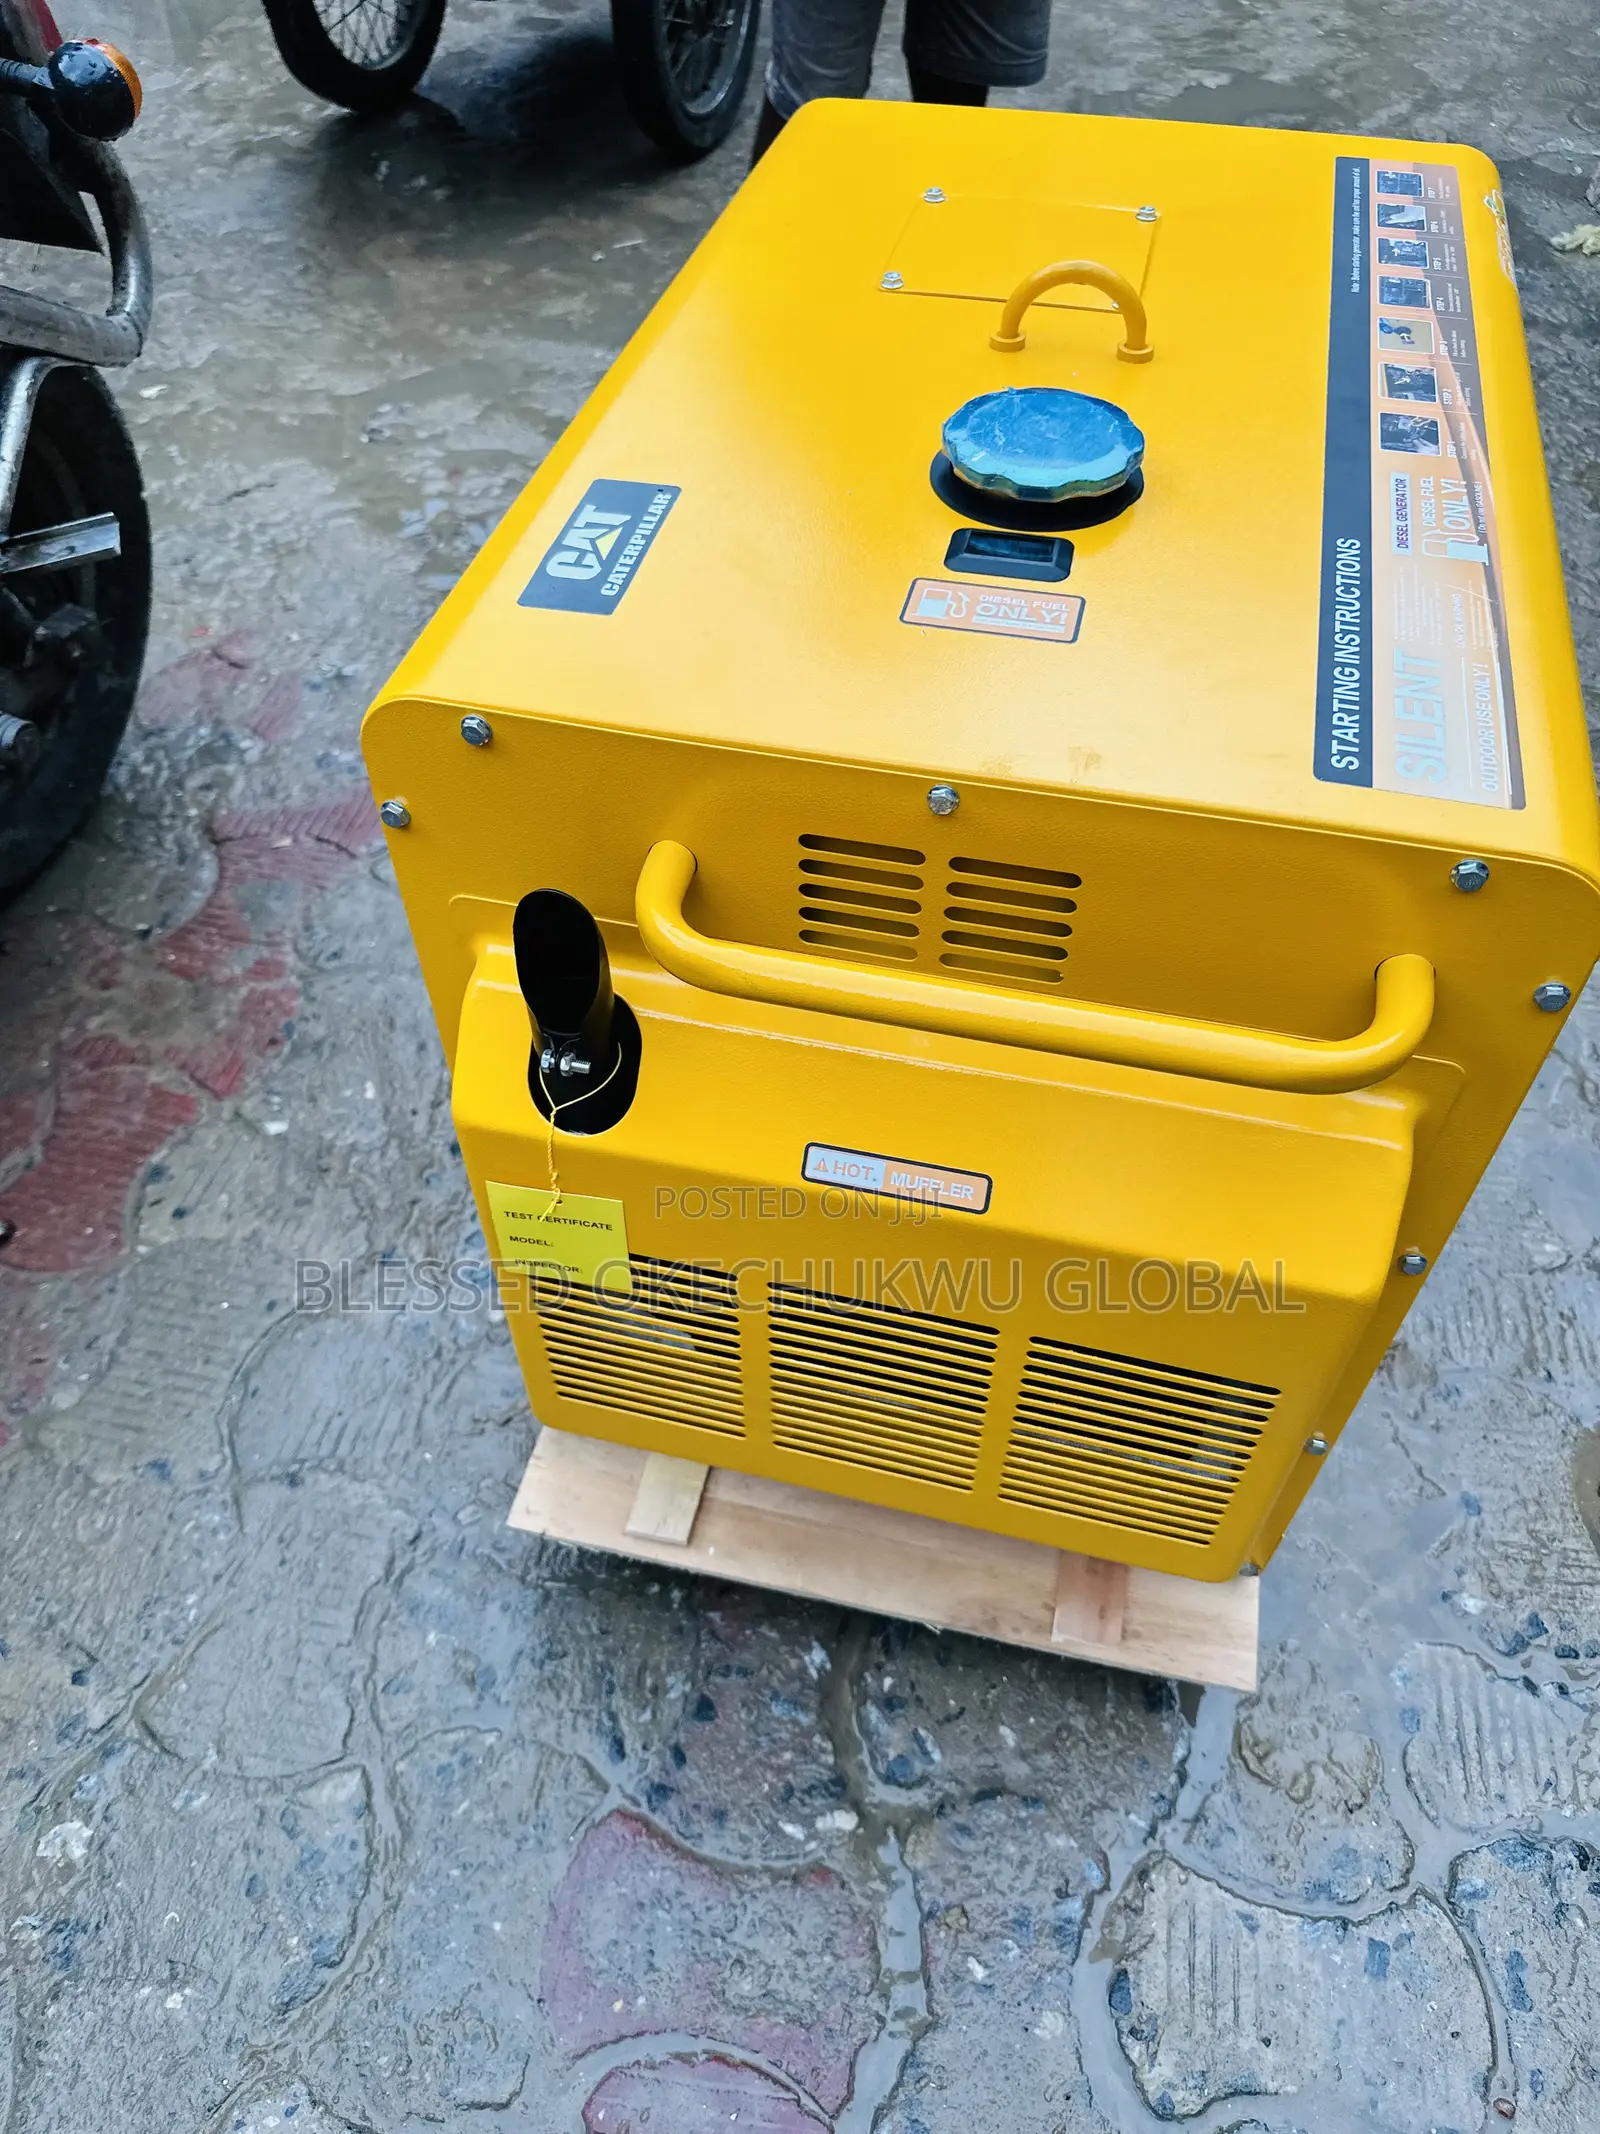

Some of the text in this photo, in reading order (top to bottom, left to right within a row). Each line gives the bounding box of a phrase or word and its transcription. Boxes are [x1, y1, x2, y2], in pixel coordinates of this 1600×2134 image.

[1433, 261, 1442, 270] STEP
[1436, 301, 1445, 311] STEP
[1439, 344, 1448, 356] STEP
[1443, 392, 1453, 405] STEP
[1447, 444, 1457, 458] STEP
[1395, 478, 1409, 549] DIESEL GENERATOR
[1420, 476, 1437, 527] DIESEL FUEL
[1439, 478, 1471, 530] ONLY!
[546, 504, 632, 580] CAT
[600, 492, 672, 596] CATERPILLAR
[976, 603, 1069, 625] ONLY!
[978, 594, 1071, 612] DIESEL FUEL
[1331, 537, 1361, 771] STARTING INSTRUCTIONS
[1393, 647, 1447, 785] SILENT
[1475, 701, 1494, 727] USE
[1477, 728, 1499, 792] OUTDOOR
[889, 1170, 974, 1200] MUFFLER
[503, 1210, 613, 1231] TEST CERTIFICATE
[509, 1235, 554, 1247] MODEL:
